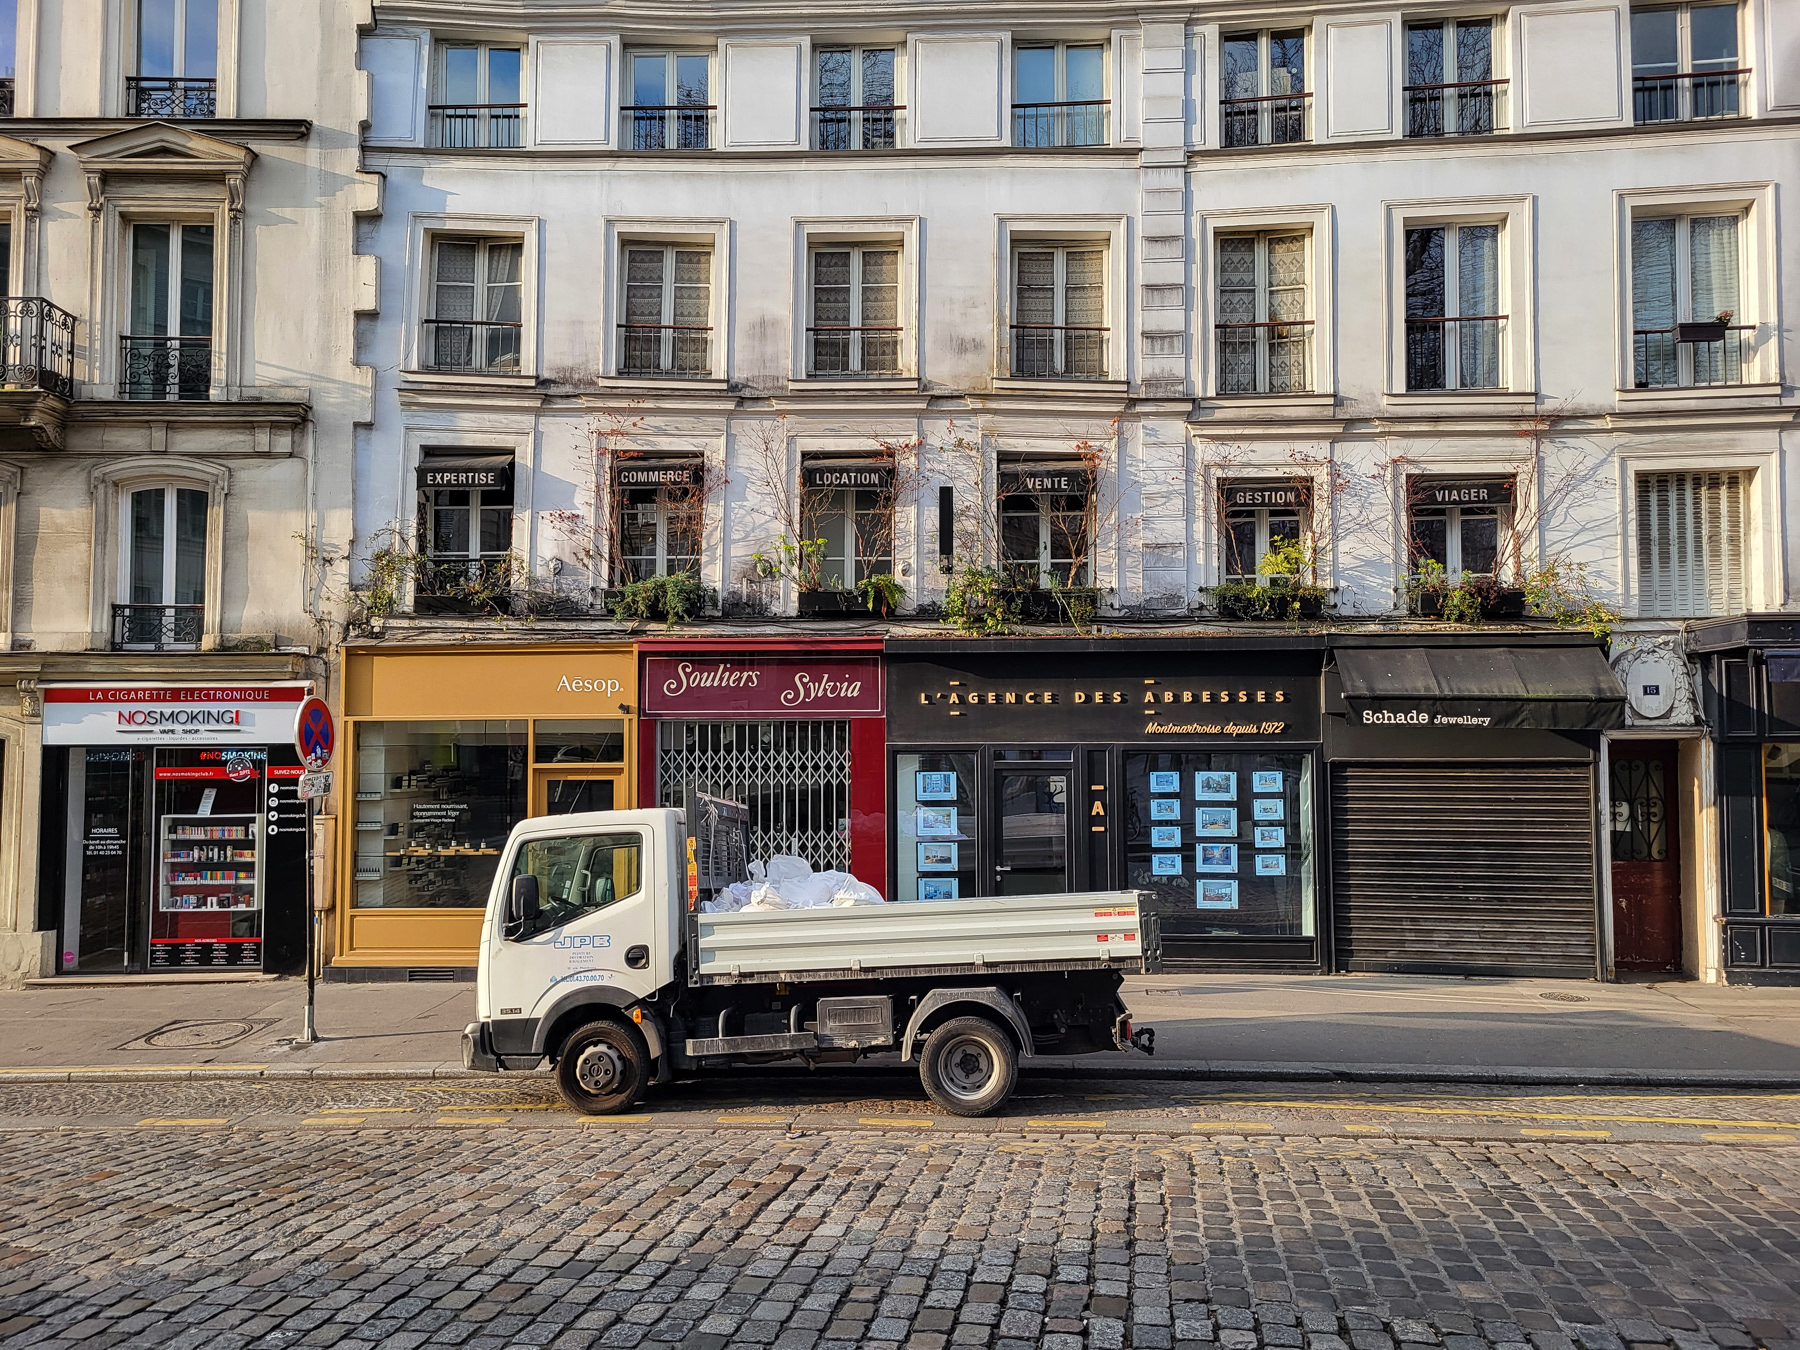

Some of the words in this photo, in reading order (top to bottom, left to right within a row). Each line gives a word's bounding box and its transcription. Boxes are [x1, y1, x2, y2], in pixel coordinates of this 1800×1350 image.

[427, 472, 495, 484] EXPERTISE
[621, 470, 690, 483] COMMERCE
[816, 472, 879, 484] LOCATION
[1026, 477, 1068, 489] VENTE
[1236, 491, 1295, 504] GESTION
[1435, 488, 1488, 502] VIAGER
[663, 662, 760, 697] Souliers
[89, 691, 104, 700] LA
[108, 690, 172, 700] CIGARETTE
[180, 690, 270, 701] ELECTRONIQUE
[780, 672, 862, 706] Sylvia
[921, 692, 1053, 704] L'AGENCE
[1075, 691, 1122, 704] DES
[1144, 690, 1285, 703] ABBESSES
[117, 709, 240, 725] NOSMOKING!
[1362, 710, 1429, 724] Schade
[1433, 715, 1491, 727] Jewellery
[1144, 721, 1222, 735] Montmartroise
[1223, 721, 1258, 737] depuis
[1260, 721, 1285, 735] 1972
[1091, 800, 1105, 816] A
[553, 934, 611, 950] JPB
